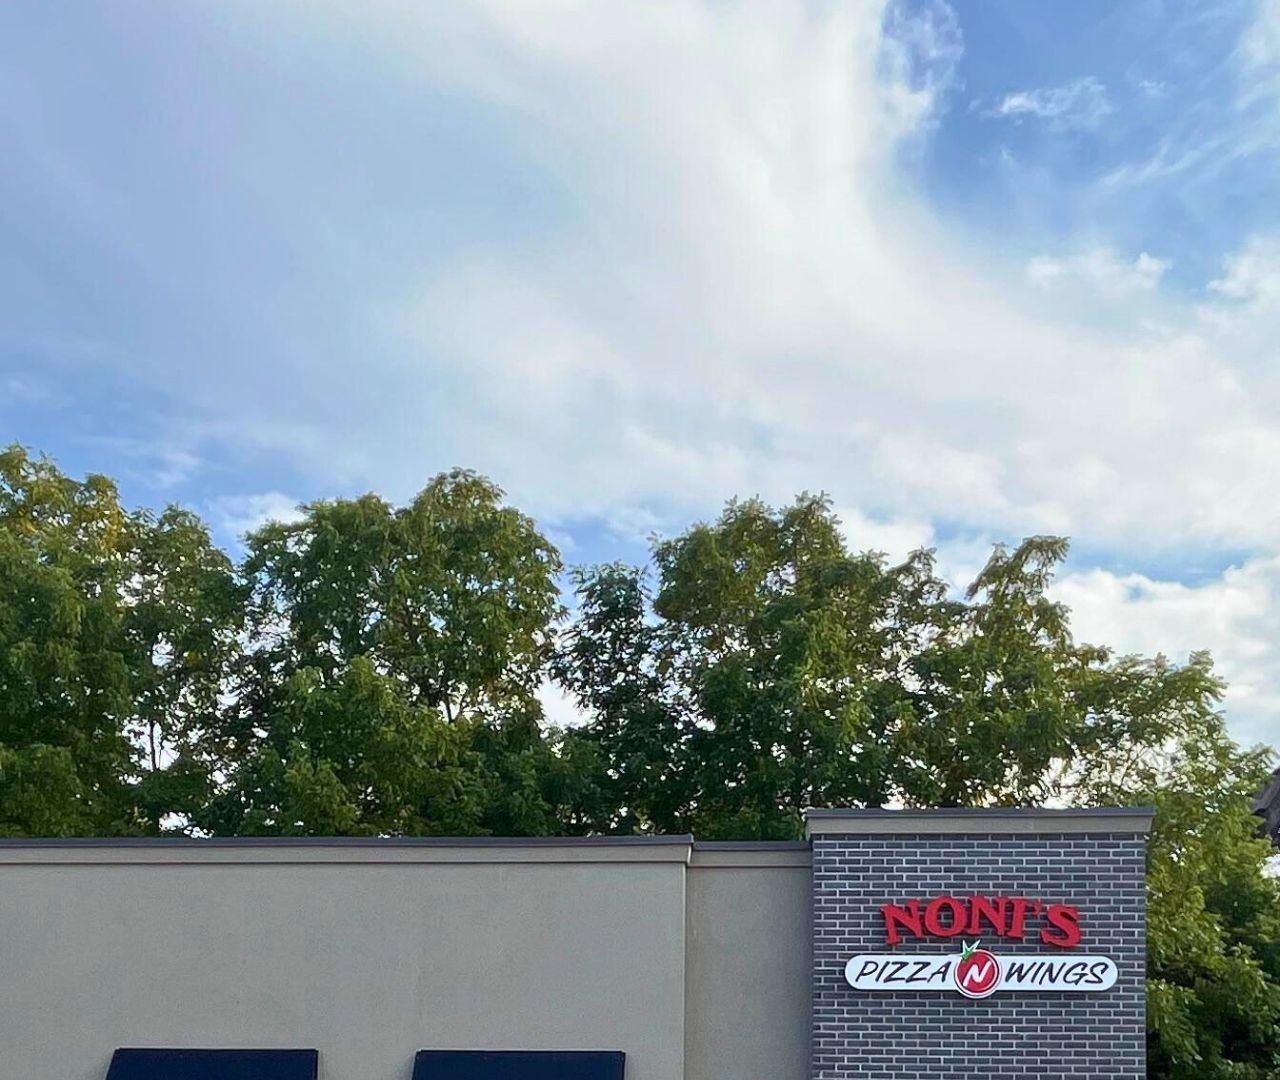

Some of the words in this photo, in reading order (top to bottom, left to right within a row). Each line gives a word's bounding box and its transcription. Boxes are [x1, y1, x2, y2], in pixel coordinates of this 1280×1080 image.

[880, 896, 1083, 948] NONI'S
[854, 960, 952, 984] PIZZA
[963, 960, 993, 987] N
[1005, 961, 1110, 986] WINGS
